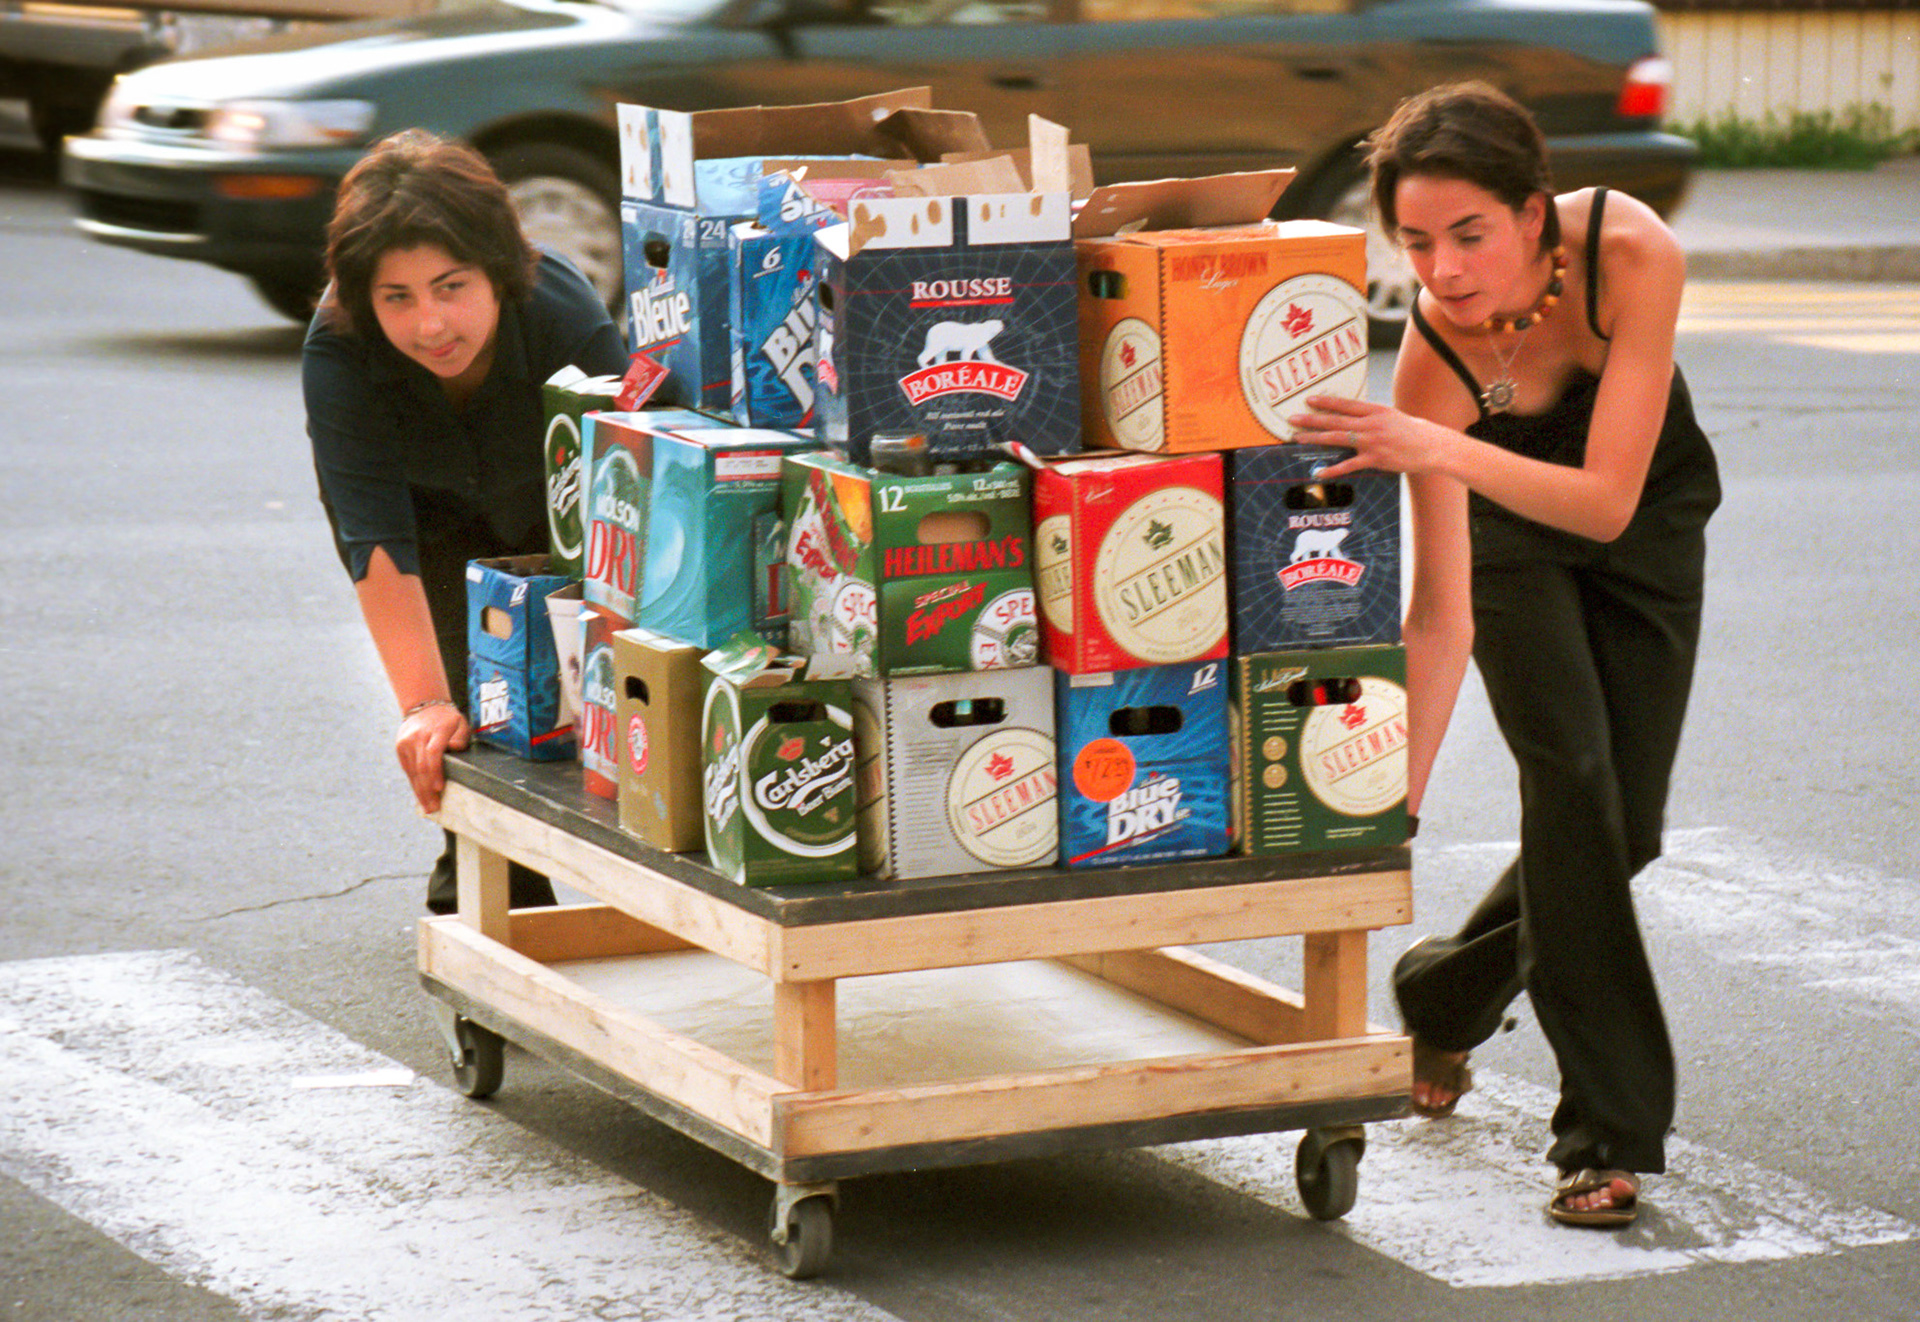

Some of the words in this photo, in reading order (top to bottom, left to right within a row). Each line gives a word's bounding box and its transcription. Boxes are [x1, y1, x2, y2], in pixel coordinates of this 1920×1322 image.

[700, 220, 727, 240] 24
[763, 246, 781, 269] 6
[911, 277, 1013, 300] ROUSSE
[631, 287, 691, 348] Bleue
[908, 365, 1020, 400] BORÉALE
[1262, 326, 1363, 400] SLEEMAN
[878, 485, 908, 513] 12
[1288, 512, 1352, 529] ROUSSE
[885, 534, 1025, 578] HEILEMAN'S
[914, 580, 972, 609] SPECIAL
[1120, 537, 1221, 621] SLEEMAN
[905, 582, 989, 646] EXPORT
[1192, 663, 1219, 691] 12
[1321, 720, 1407, 779] SLEEMAN
[754, 738, 855, 811] Carlsberg
[968, 767, 1057, 831] SLEEMAN
[1108, 777, 1180, 816] Blue
[1106, 792, 1183, 846] DRY
